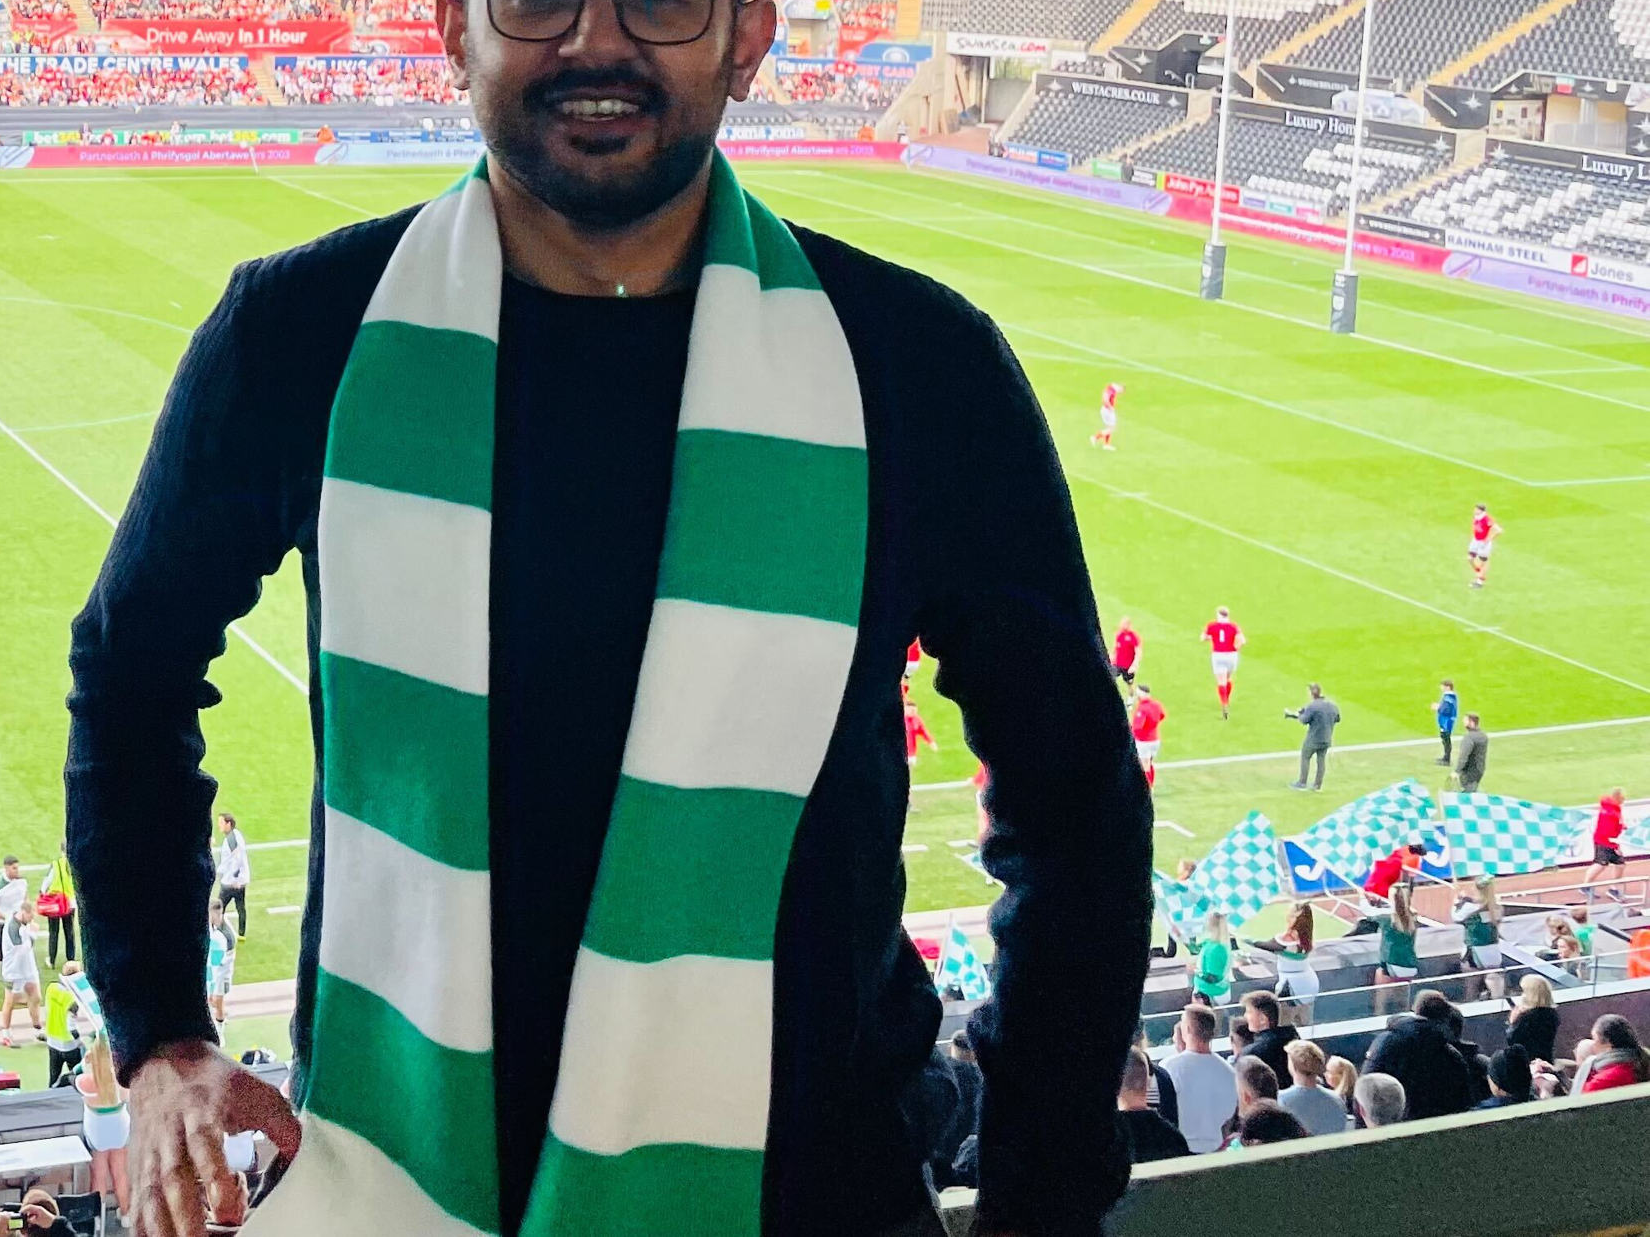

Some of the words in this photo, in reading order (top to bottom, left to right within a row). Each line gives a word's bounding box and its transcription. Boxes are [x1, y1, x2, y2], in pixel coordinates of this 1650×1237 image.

[146, 28, 188, 44] Drive
[192, 29, 234, 47] Away
[238, 28, 254, 43] In
[258, 28, 264, 43] 1
[269, 28, 307, 44] Hour
[35, 57, 98, 74] TRADE
[103, 56, 173, 74] CENTRE
[177, 57, 240, 74] WALES
[1072, 81, 1160, 105] WESTACRES.CO.UK
[1285, 110, 1326, 134] Luxury
[1328, 117, 1369, 138] Homs
[1582, 155, 1634, 181] Luxury
[1447, 234, 1503, 255] RAINHAM
[1507, 247, 1546, 263] STEEL
[1591, 262, 1634, 283] Jones
